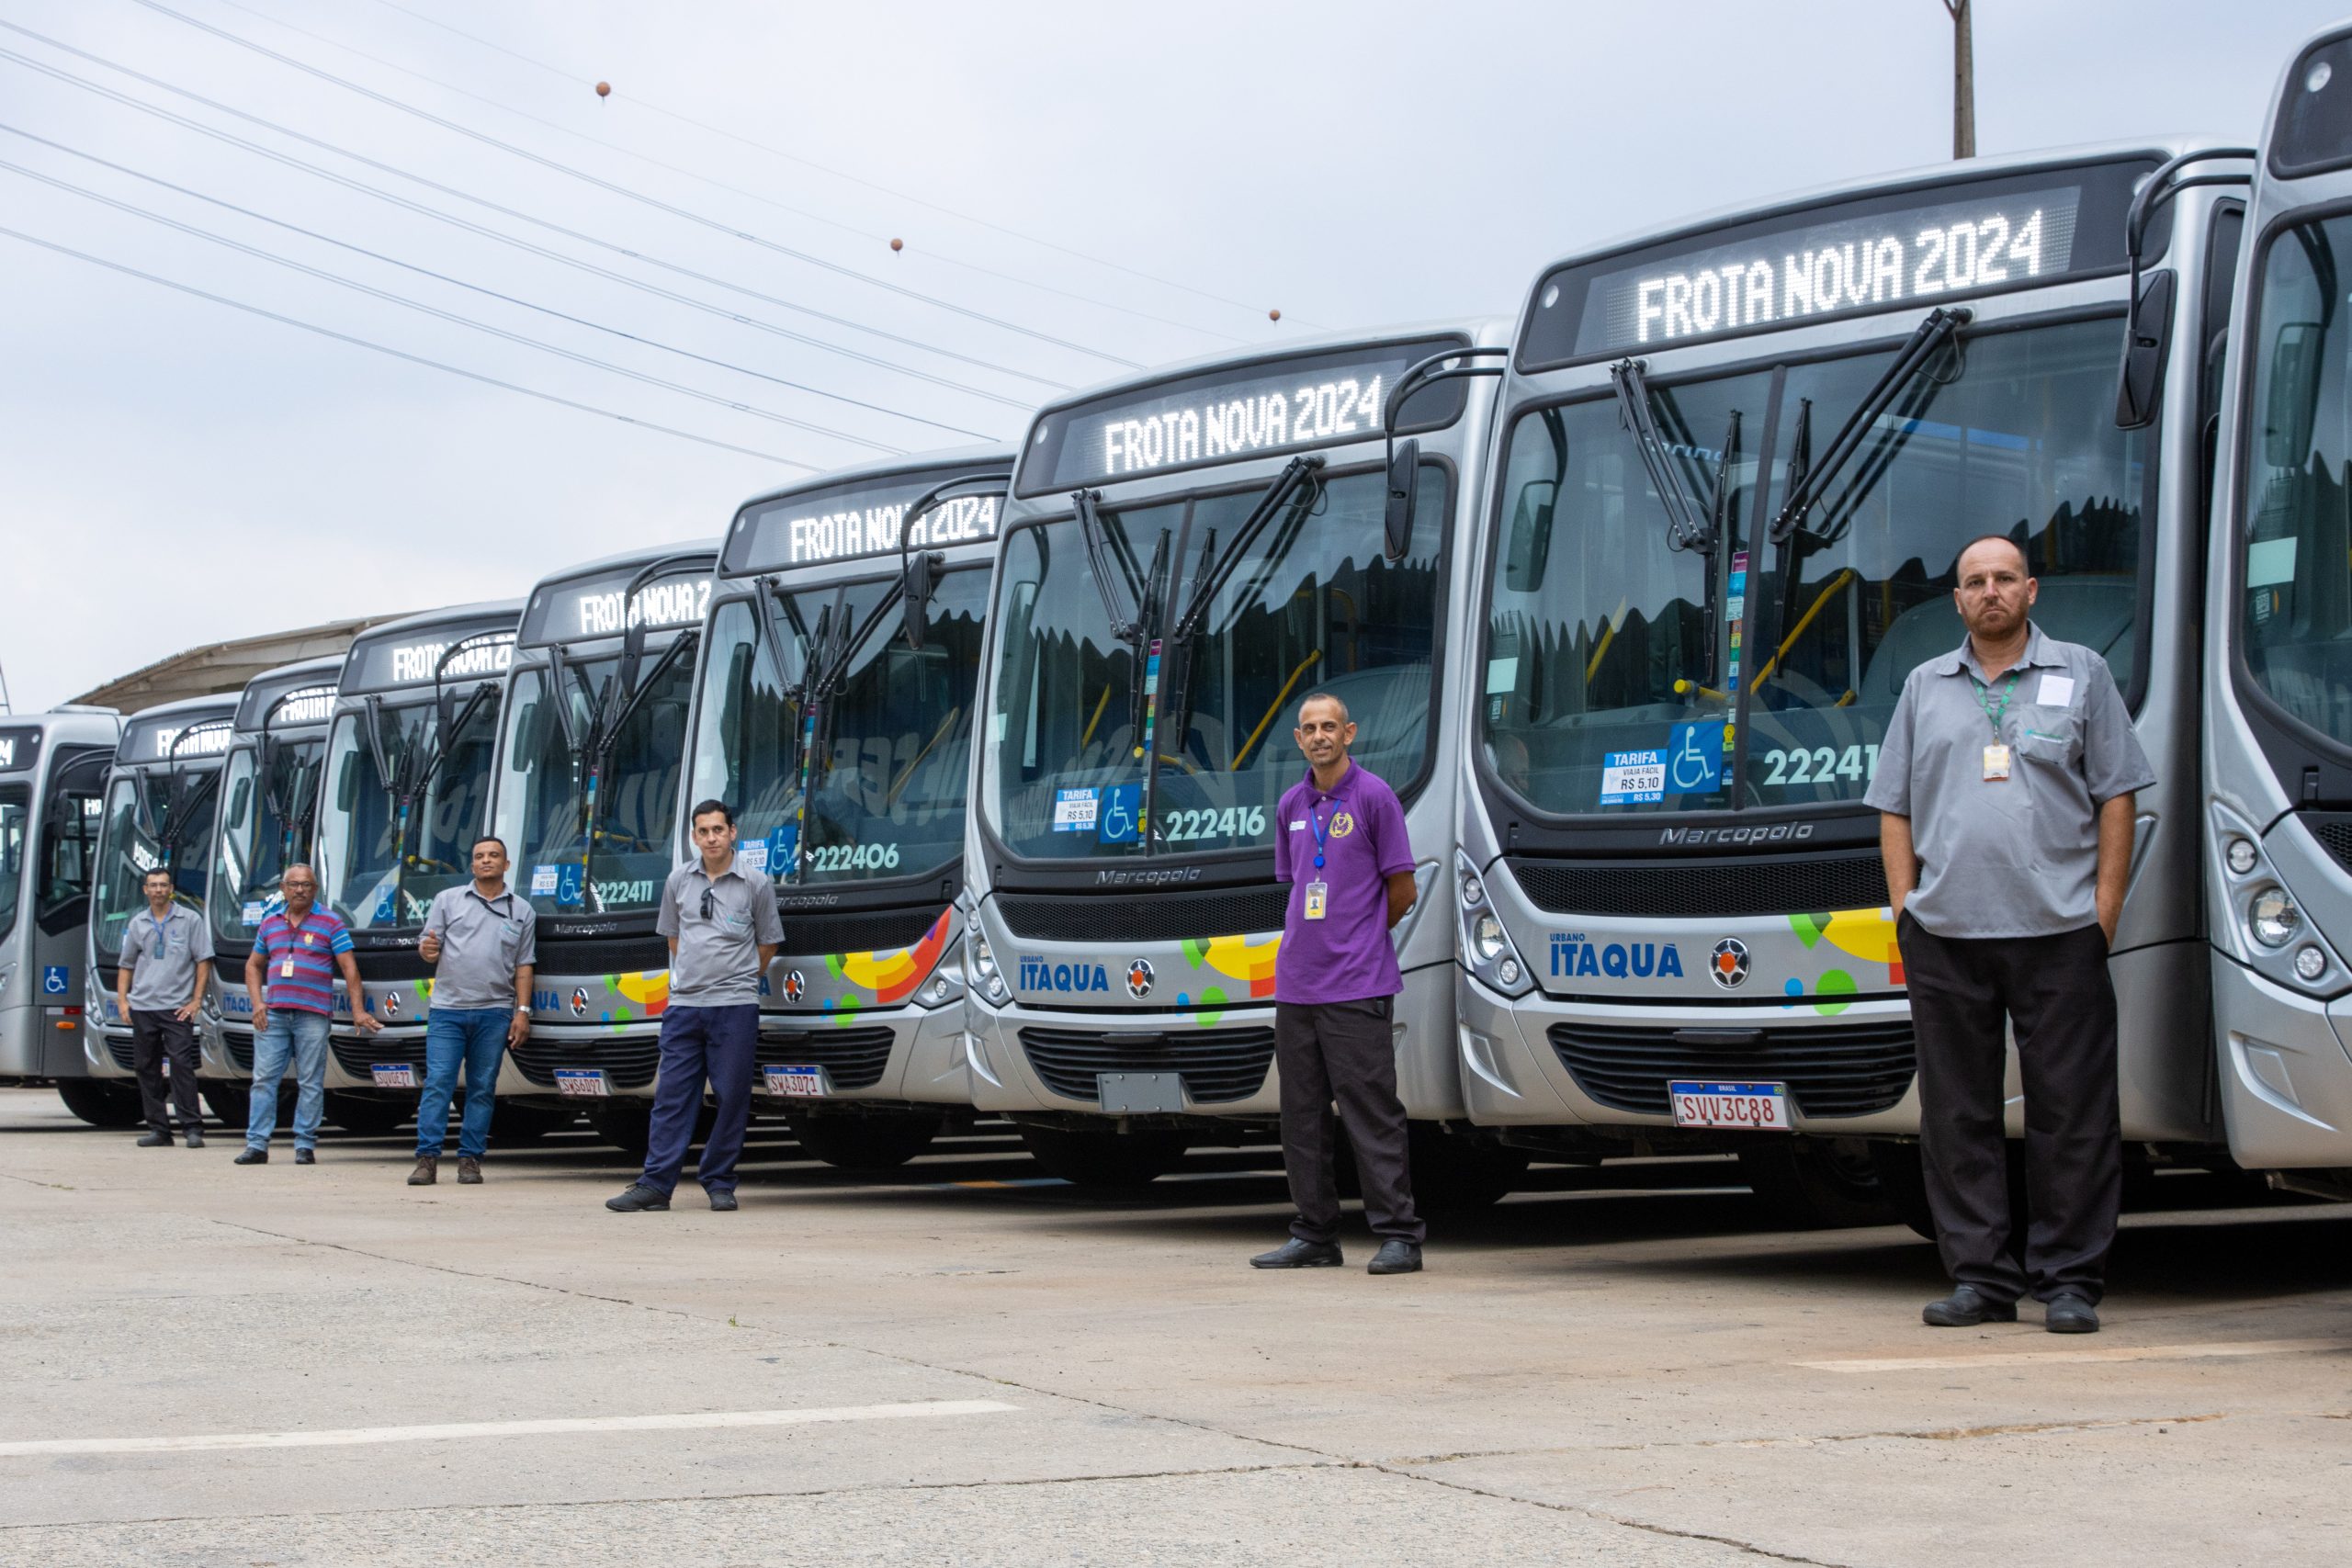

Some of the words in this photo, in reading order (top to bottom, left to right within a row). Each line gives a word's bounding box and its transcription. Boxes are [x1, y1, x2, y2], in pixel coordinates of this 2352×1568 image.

[1637, 258, 1774, 343] FROTA
[1784, 236, 1904, 318] NOVA
[1914, 209, 2041, 296] 2024
[1105, 409, 1199, 475] FROTA
[1205, 393, 1287, 457] NOVA
[1294, 375, 1381, 441] 2024
[790, 512, 862, 563] FROTA
[932, 496, 995, 543] 2024
[580, 592, 641, 634] FROTA
[643, 583, 695, 626] NOVA
[1613, 751, 1657, 766] TARIFA
[1763, 744, 1882, 785] 22241
[1063, 789, 1092, 800] TARIFA
[1621, 778, 1635, 790] R$
[1634, 793, 1644, 802] R$
[1166, 806, 1266, 841] 222416
[1658, 822, 1814, 846] Marcopolo
[813, 842, 899, 872] 222406
[1095, 866, 1202, 886] Marcopolo
[598, 880, 654, 904] 222411
[775, 894, 839, 908] arcopolo
[407, 898, 435, 919] 222
[553, 921, 617, 935] Marcopolo
[1549, 932, 1586, 942] URBANO
[223, 996, 253, 1012] ITAQU
[1683, 1097, 1775, 1122] SVV3C88
